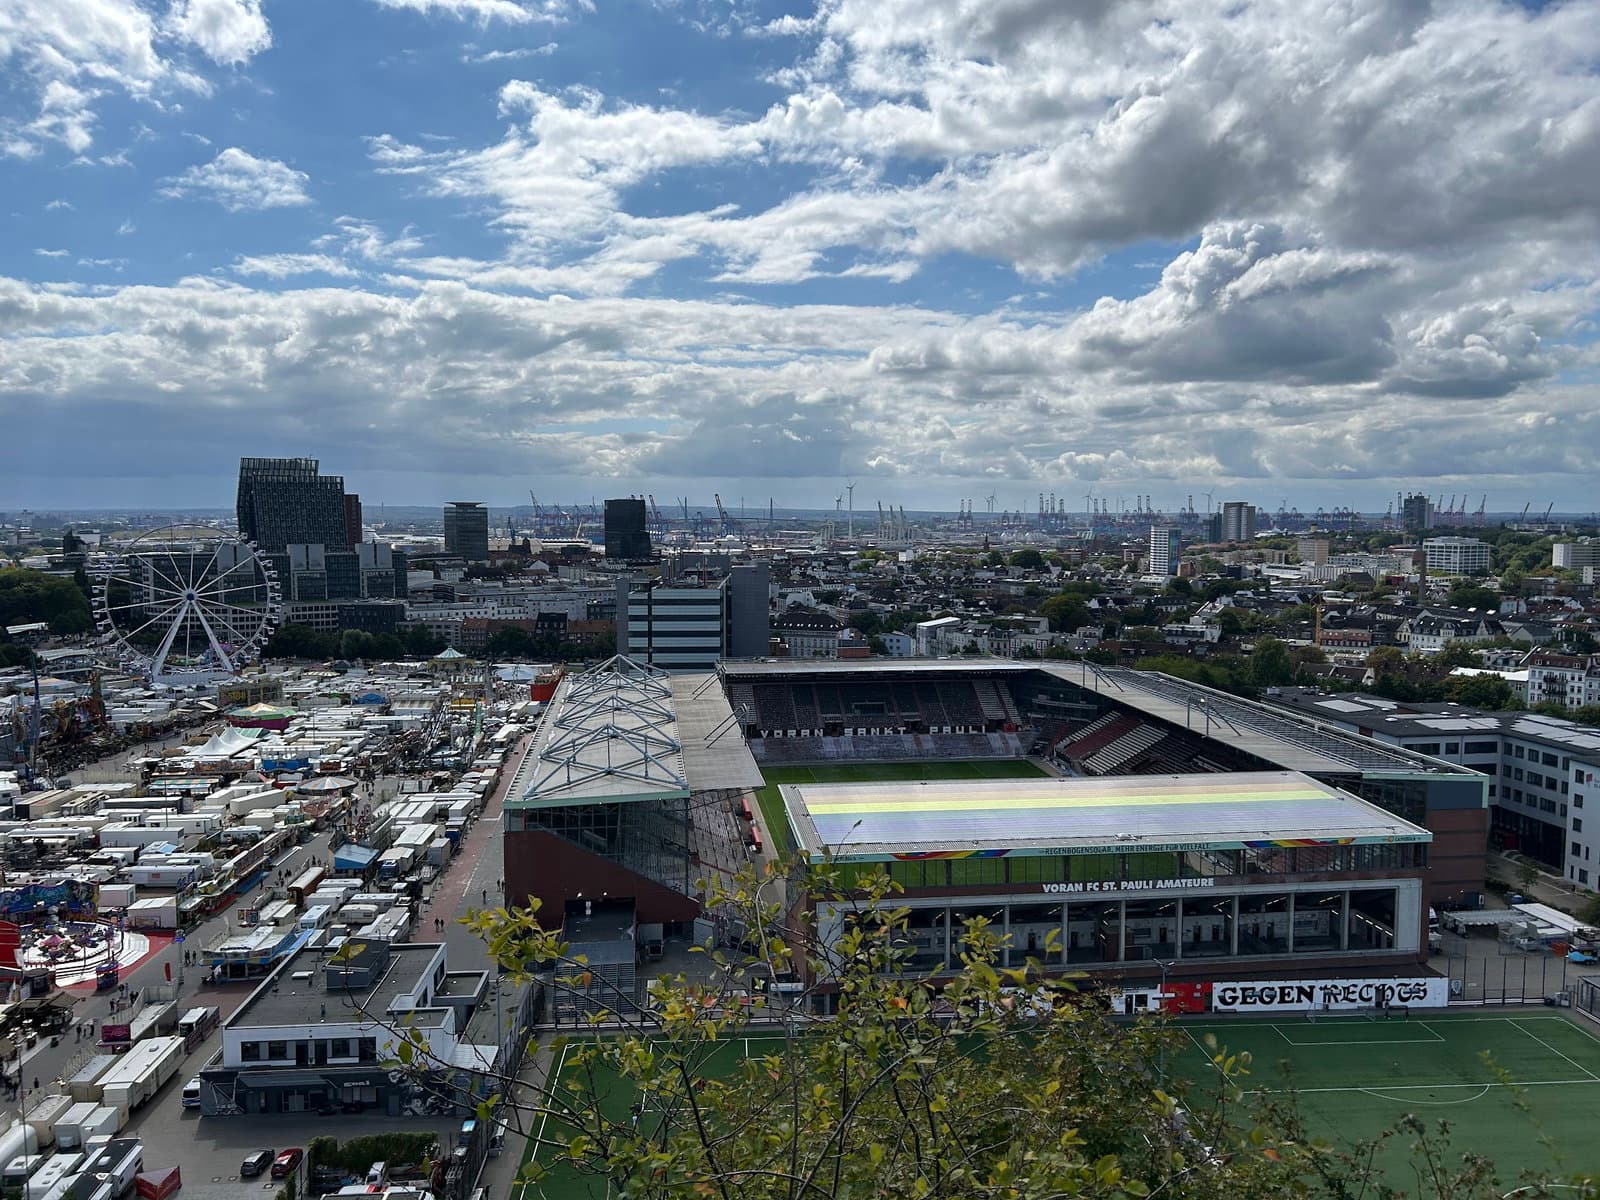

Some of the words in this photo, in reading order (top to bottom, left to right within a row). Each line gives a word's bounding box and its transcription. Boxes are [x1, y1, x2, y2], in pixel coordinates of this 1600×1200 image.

[760, 729, 824, 738] VORAN
[844, 727, 906, 737] SANKT
[929, 725, 986, 735] PAULI
[1042, 883, 1083, 893] VORAN
[1086, 882, 1100, 892] FC
[1102, 881, 1118, 891] ST.
[1120, 879, 1153, 891] PAULI
[1155, 878, 1214, 889] AMATEURE
[1217, 985, 1316, 1006] GEGEN
[1319, 982, 1427, 1004] RECHTS
